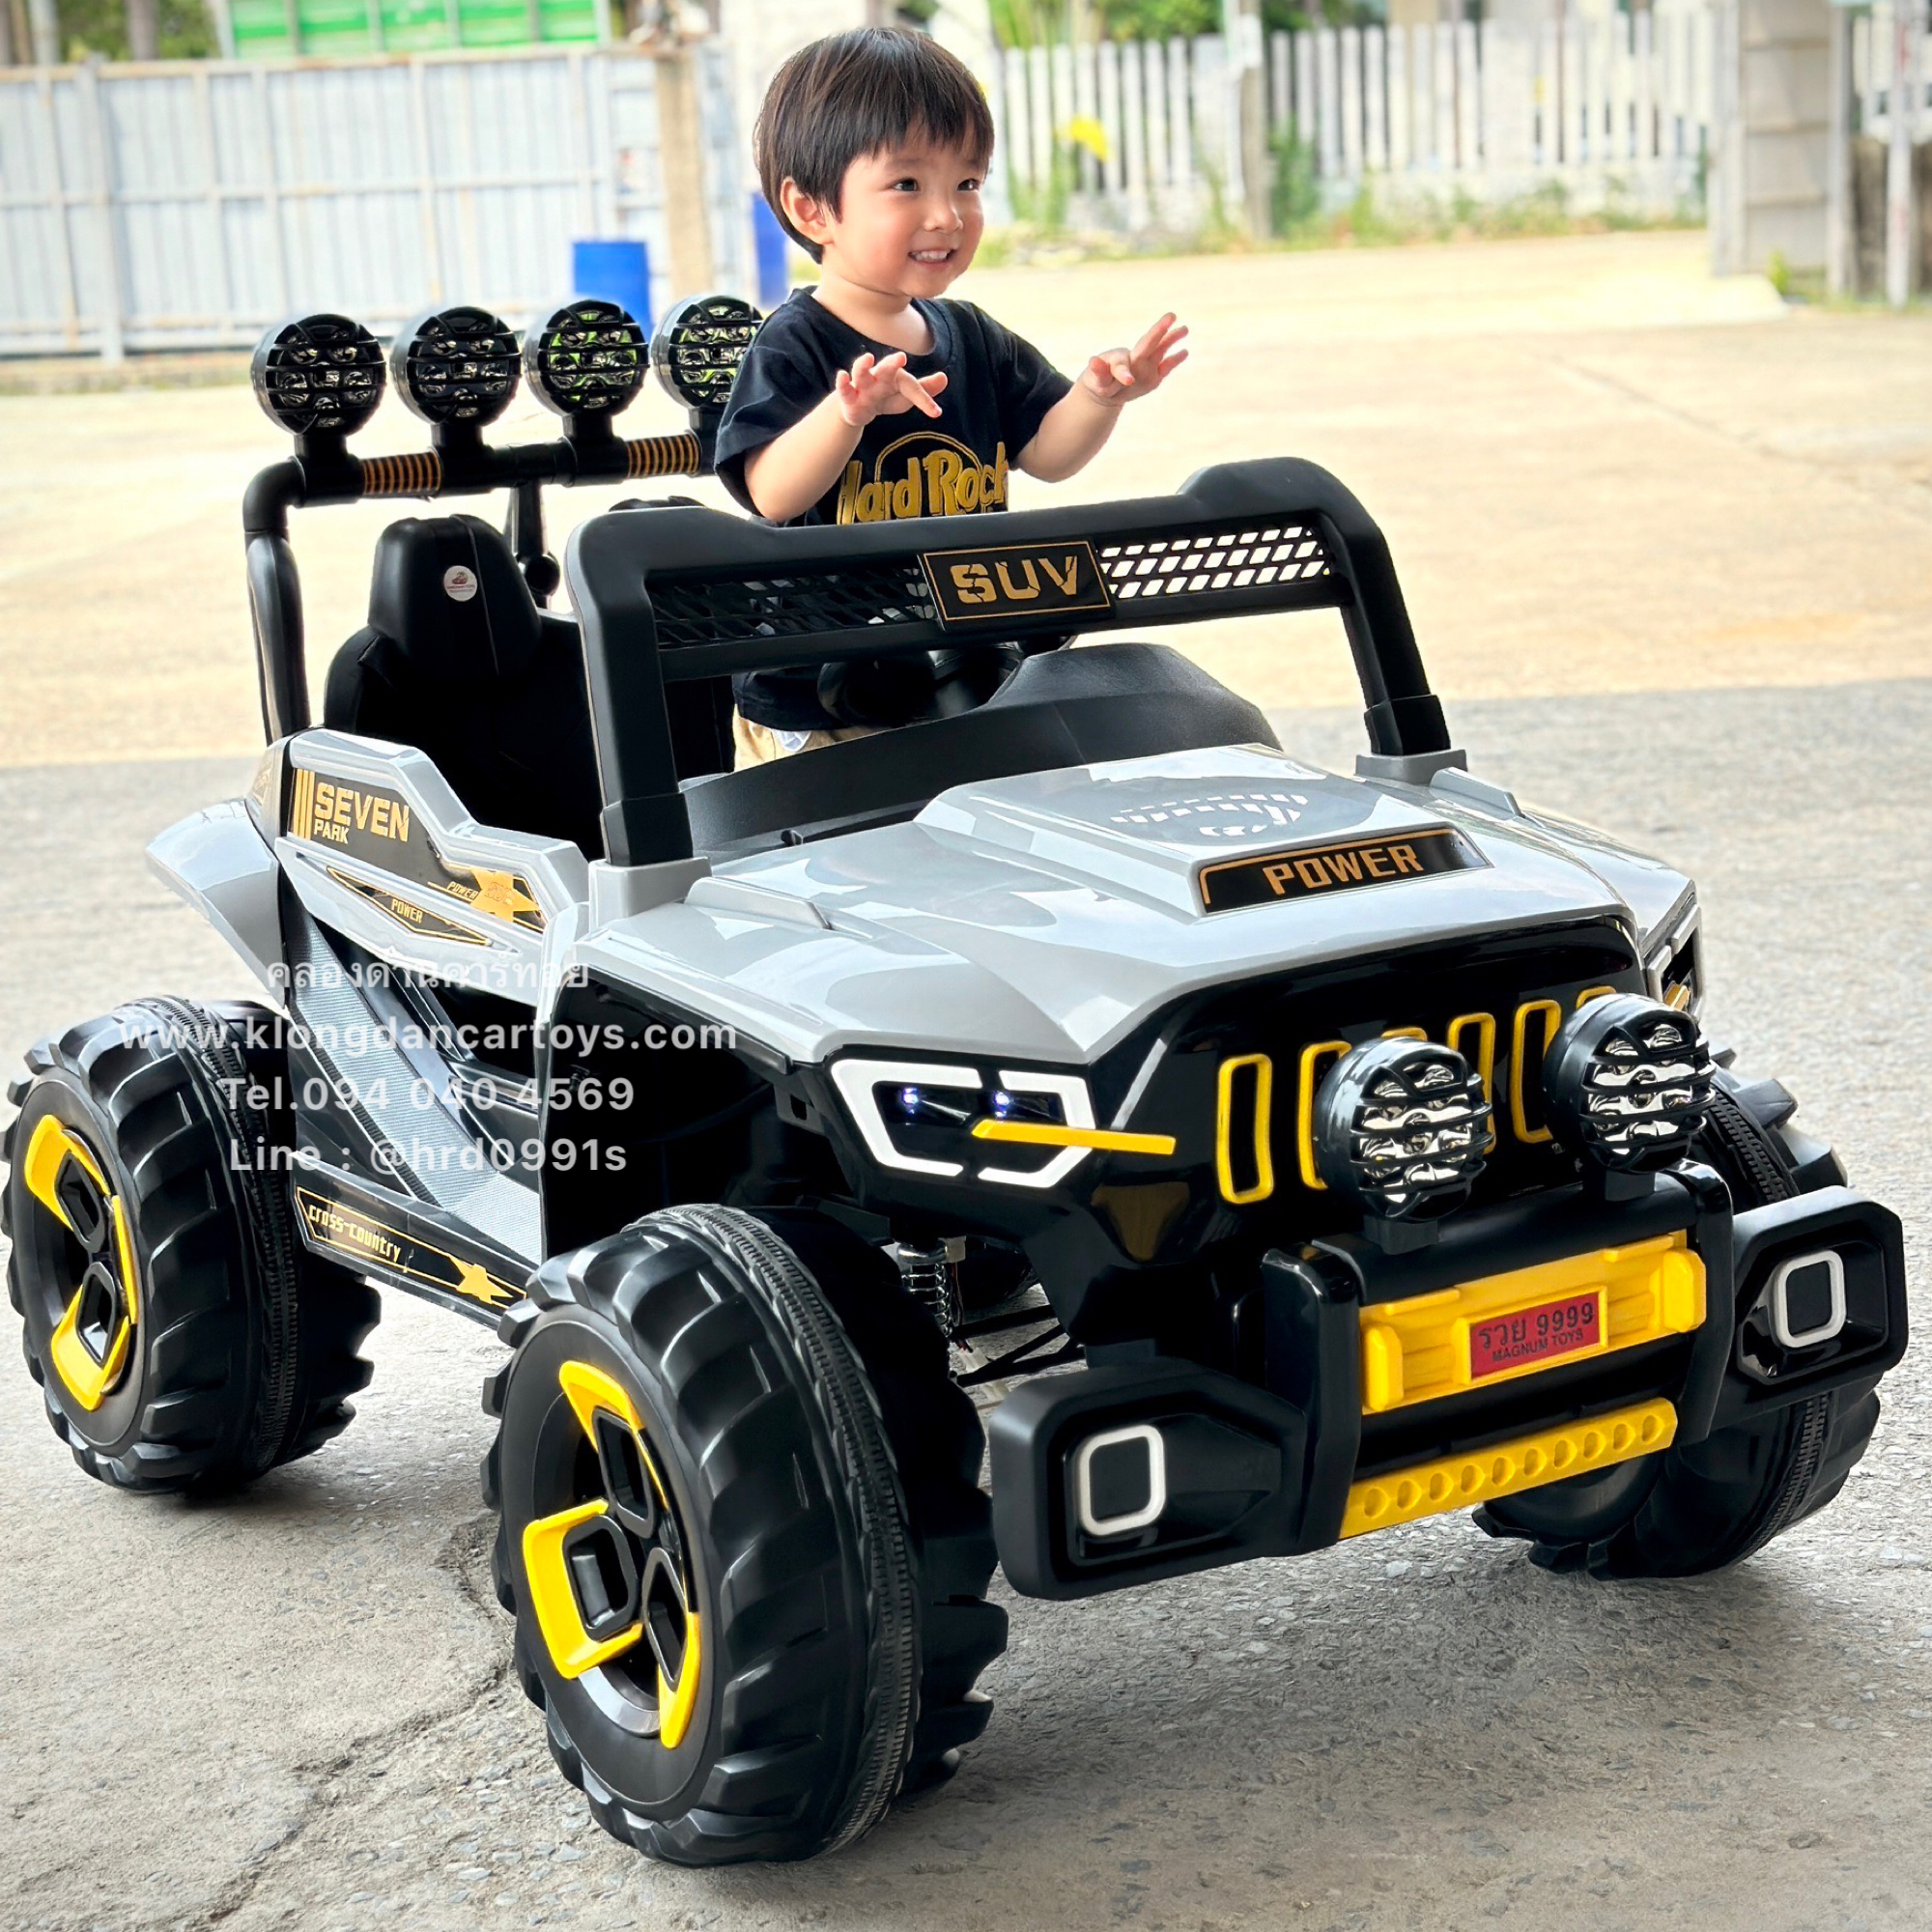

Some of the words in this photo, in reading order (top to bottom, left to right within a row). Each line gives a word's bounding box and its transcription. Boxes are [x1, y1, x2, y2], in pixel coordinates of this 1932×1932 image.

[836, 457, 922, 526] Hard
[922, 440, 1009, 517] Rock
[949, 554, 1078, 604] SUV
[313, 781, 411, 842] SEVEN
[313, 818, 350, 844] PARK
[446, 880, 479, 900] POWER
[1262, 843, 1425, 896] POWER
[390, 897, 423, 924] POWER
[308, 1204, 402, 1264] cross-country
[1478, 1318, 1526, 1351] รวย
[1535, 1302, 1595, 1337] 9999
[1492, 1338, 1548, 1363] MAGNUM
[1551, 1327, 1584, 1347] TOYS
